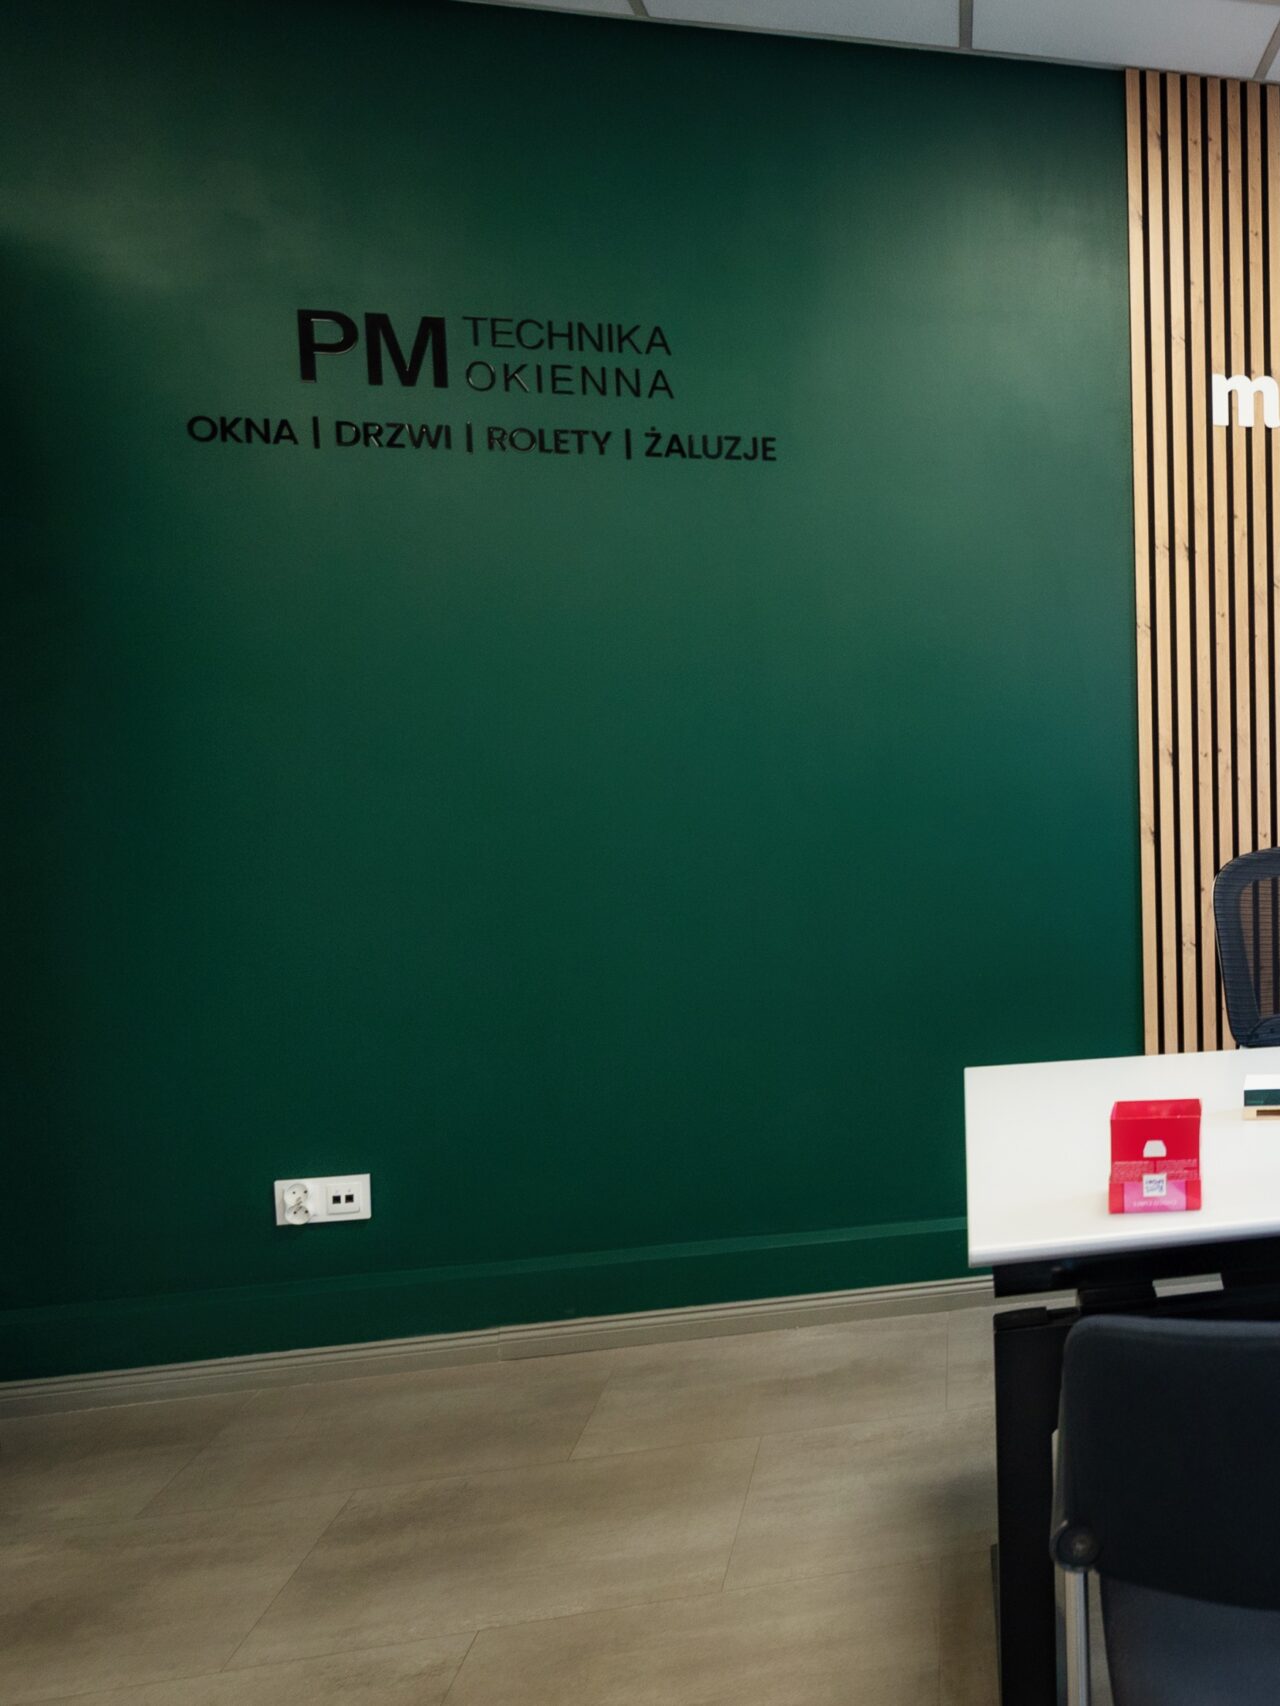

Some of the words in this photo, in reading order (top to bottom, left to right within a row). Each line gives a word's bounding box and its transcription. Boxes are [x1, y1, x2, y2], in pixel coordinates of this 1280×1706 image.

[297, 308, 450, 389] PM
[462, 315, 673, 356] TECHNIKA
[465, 360, 674, 399] OKIENNA
[187, 415, 299, 446] OKNA
[335, 419, 453, 450] DRZWI
[487, 426, 612, 456] ROLETY
[645, 425, 778, 462] ŻALUZJE
